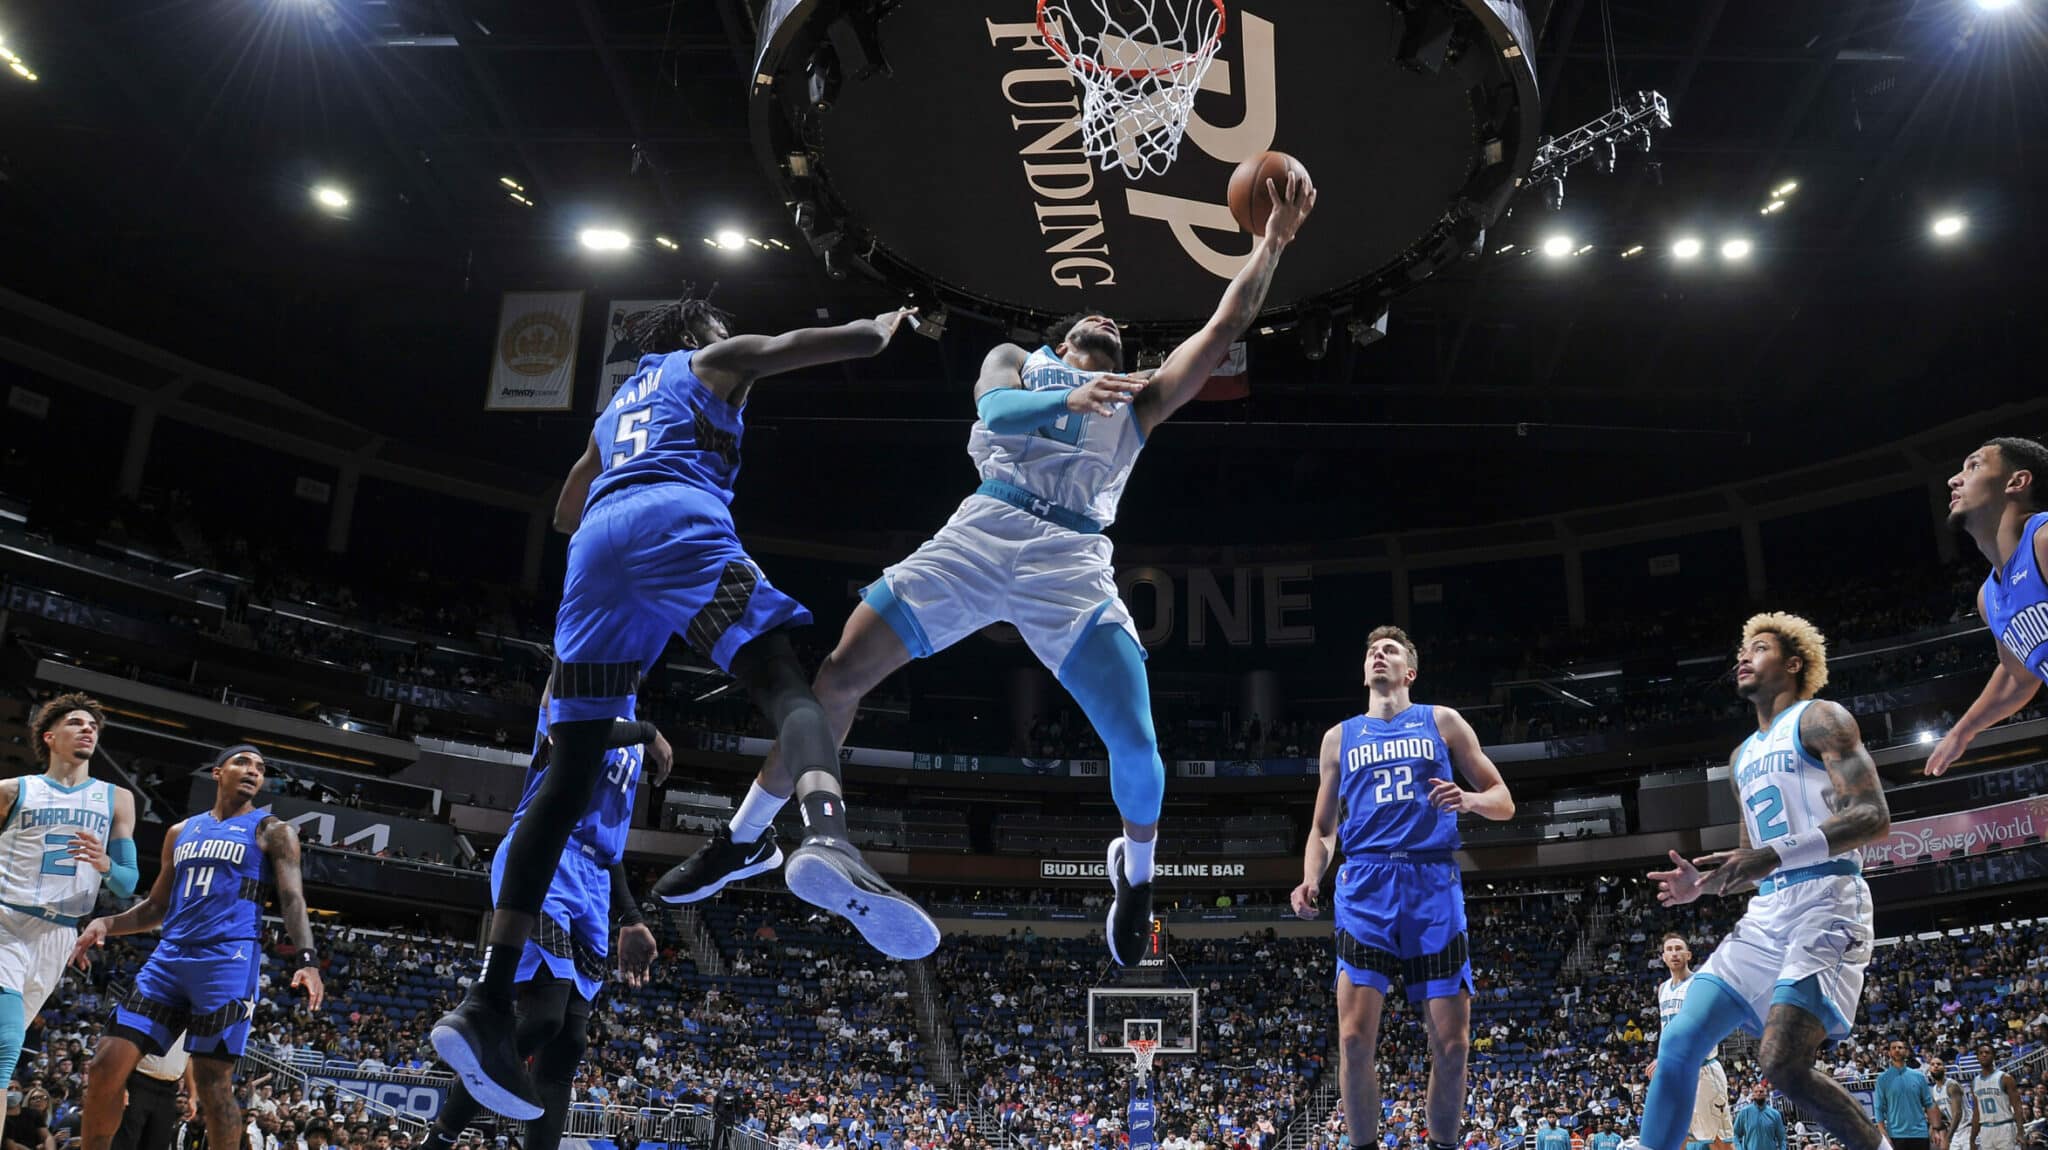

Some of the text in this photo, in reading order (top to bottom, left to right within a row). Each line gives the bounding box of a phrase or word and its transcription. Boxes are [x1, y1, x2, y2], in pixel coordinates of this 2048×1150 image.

[985, 15, 1116, 289] FUNDING
[611, 407, 652, 469] 5
[607, 747, 637, 793] 31
[934, 756, 942, 769] 0
[971, 757, 979, 771] 3
[1347, 738, 1434, 772] ORLANDO
[1738, 750, 1795, 787] HARLOTTE
[1373, 765, 1414, 804] 22
[21, 807, 108, 834] CHARLOTTE
[1976, 815, 2034, 843] World
[40, 833, 80, 876] 2
[173, 839, 246, 868] ORLANDO
[184, 866, 215, 898] 14
[1043, 864, 1245, 876] BUD LIG SELINE BAR
[1980, 1097, 1998, 1114] 10
